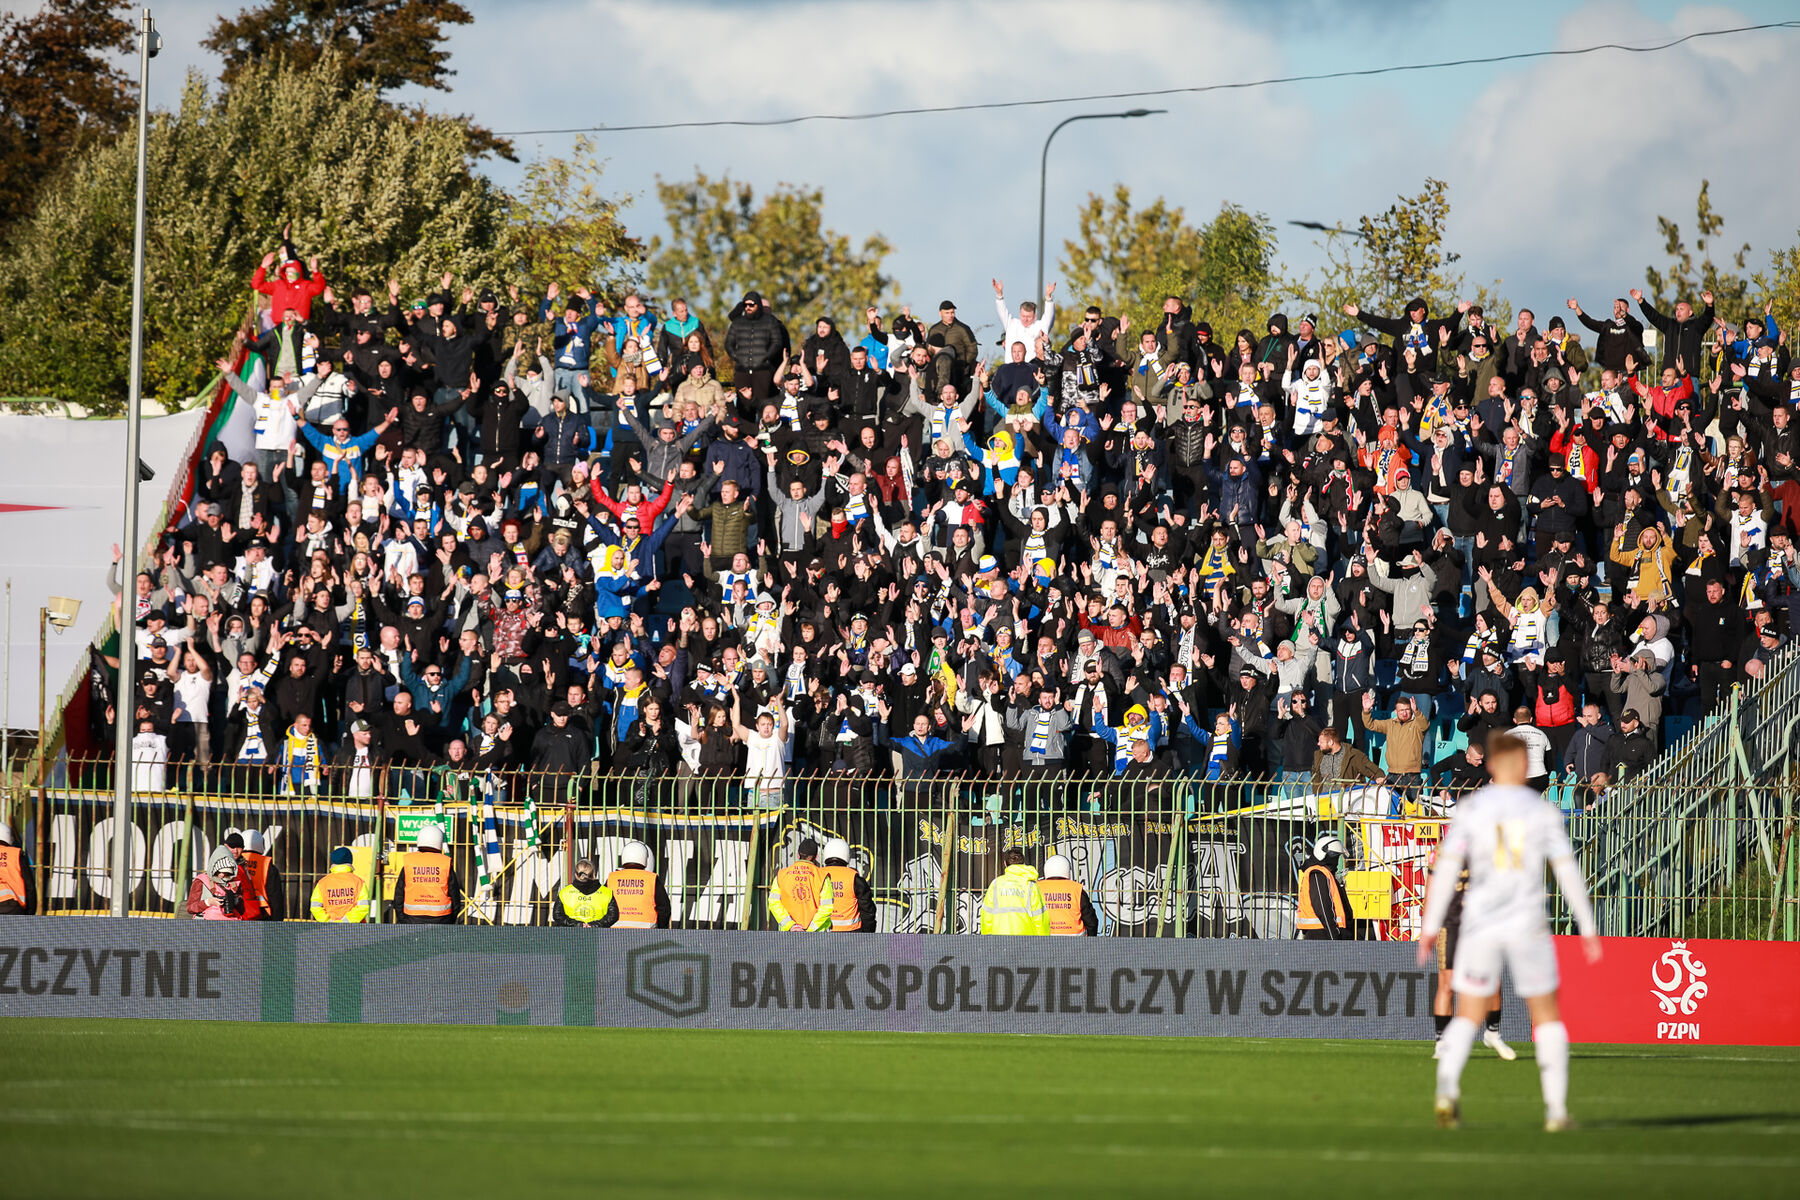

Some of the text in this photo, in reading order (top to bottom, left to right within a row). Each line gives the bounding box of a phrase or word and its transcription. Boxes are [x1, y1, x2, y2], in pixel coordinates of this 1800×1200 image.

[1419, 826, 1432, 835] XII
[413, 866, 440, 875] TAURUS
[617, 879, 644, 887] TAURUS
[327, 888, 355, 898] TAURUS
[1044, 893, 1072, 901] TAURUS
[0, 947, 222, 999] ZCZYTNIE
[730, 962, 856, 1010] BANK
[865, 956, 1195, 1016] SPÓŁDZIELCZY
[1205, 969, 1247, 1016] W
[1657, 1022, 1700, 1040] PZPN
